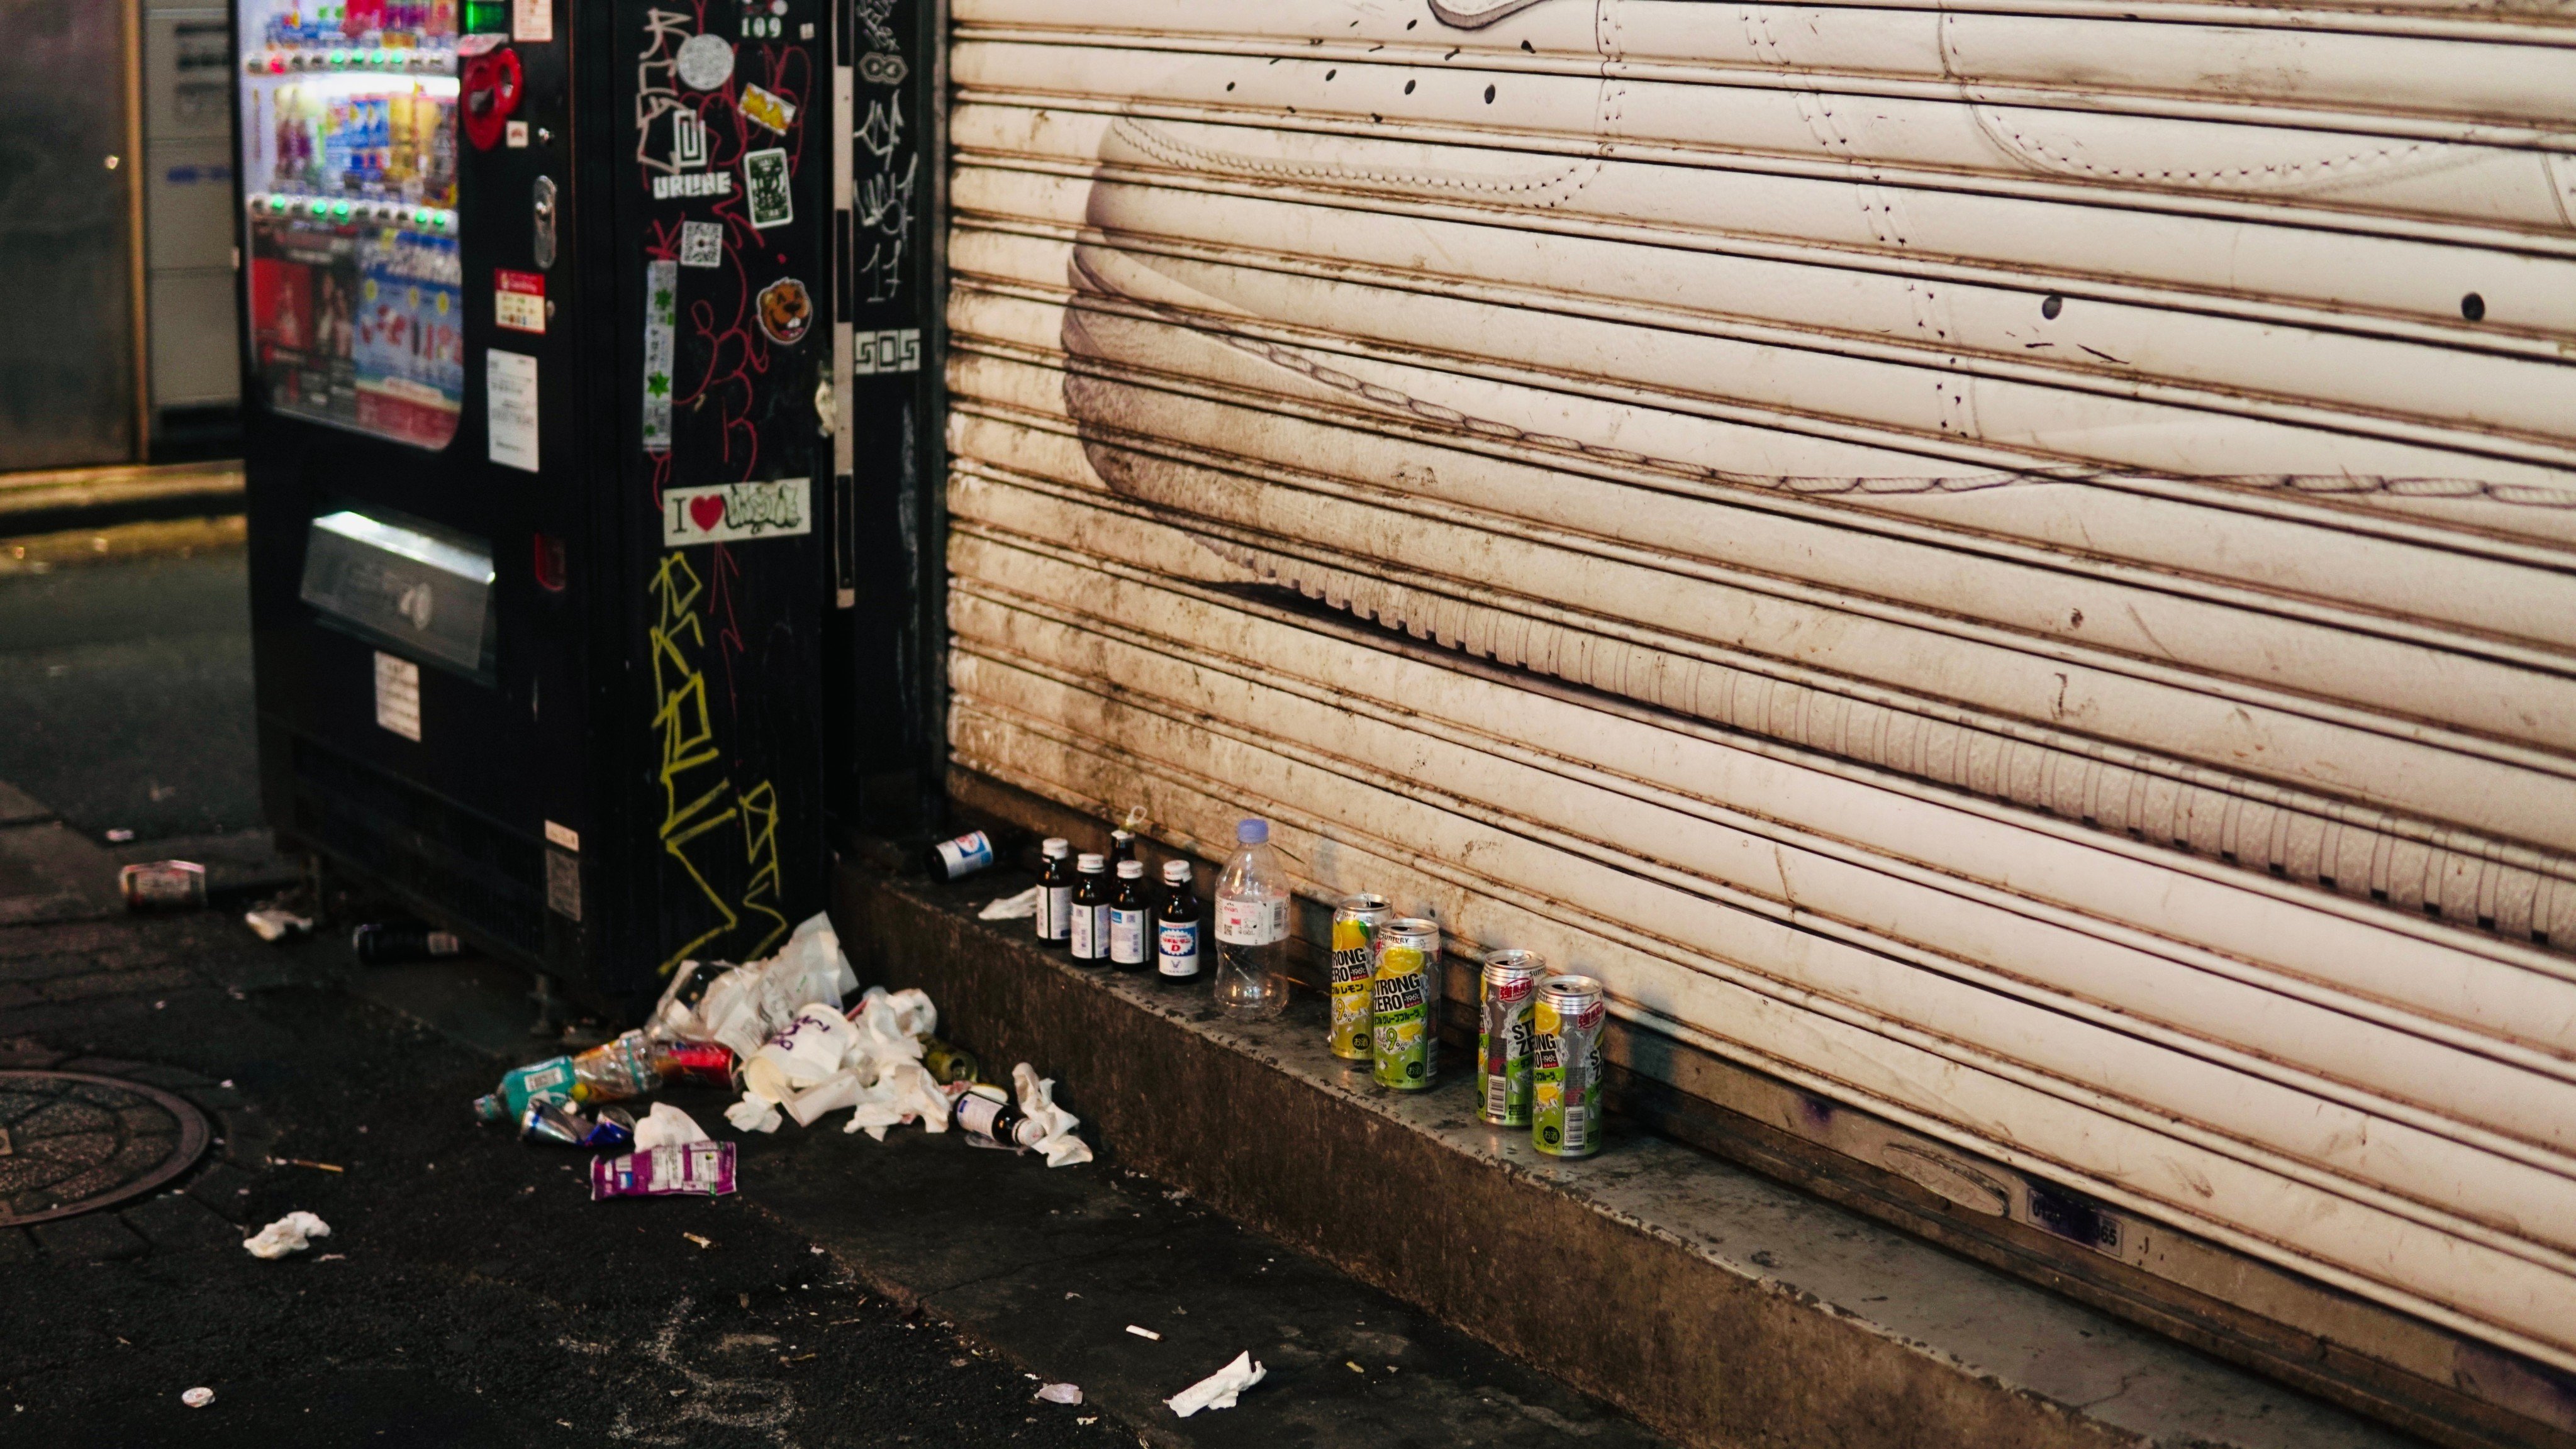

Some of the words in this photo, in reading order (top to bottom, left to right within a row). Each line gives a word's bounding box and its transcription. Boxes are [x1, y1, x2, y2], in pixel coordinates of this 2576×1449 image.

[1381, 933, 1409, 943] SUNTORY
[1332, 947, 1368, 967] RONG
[1332, 966, 1349, 983] ERO
